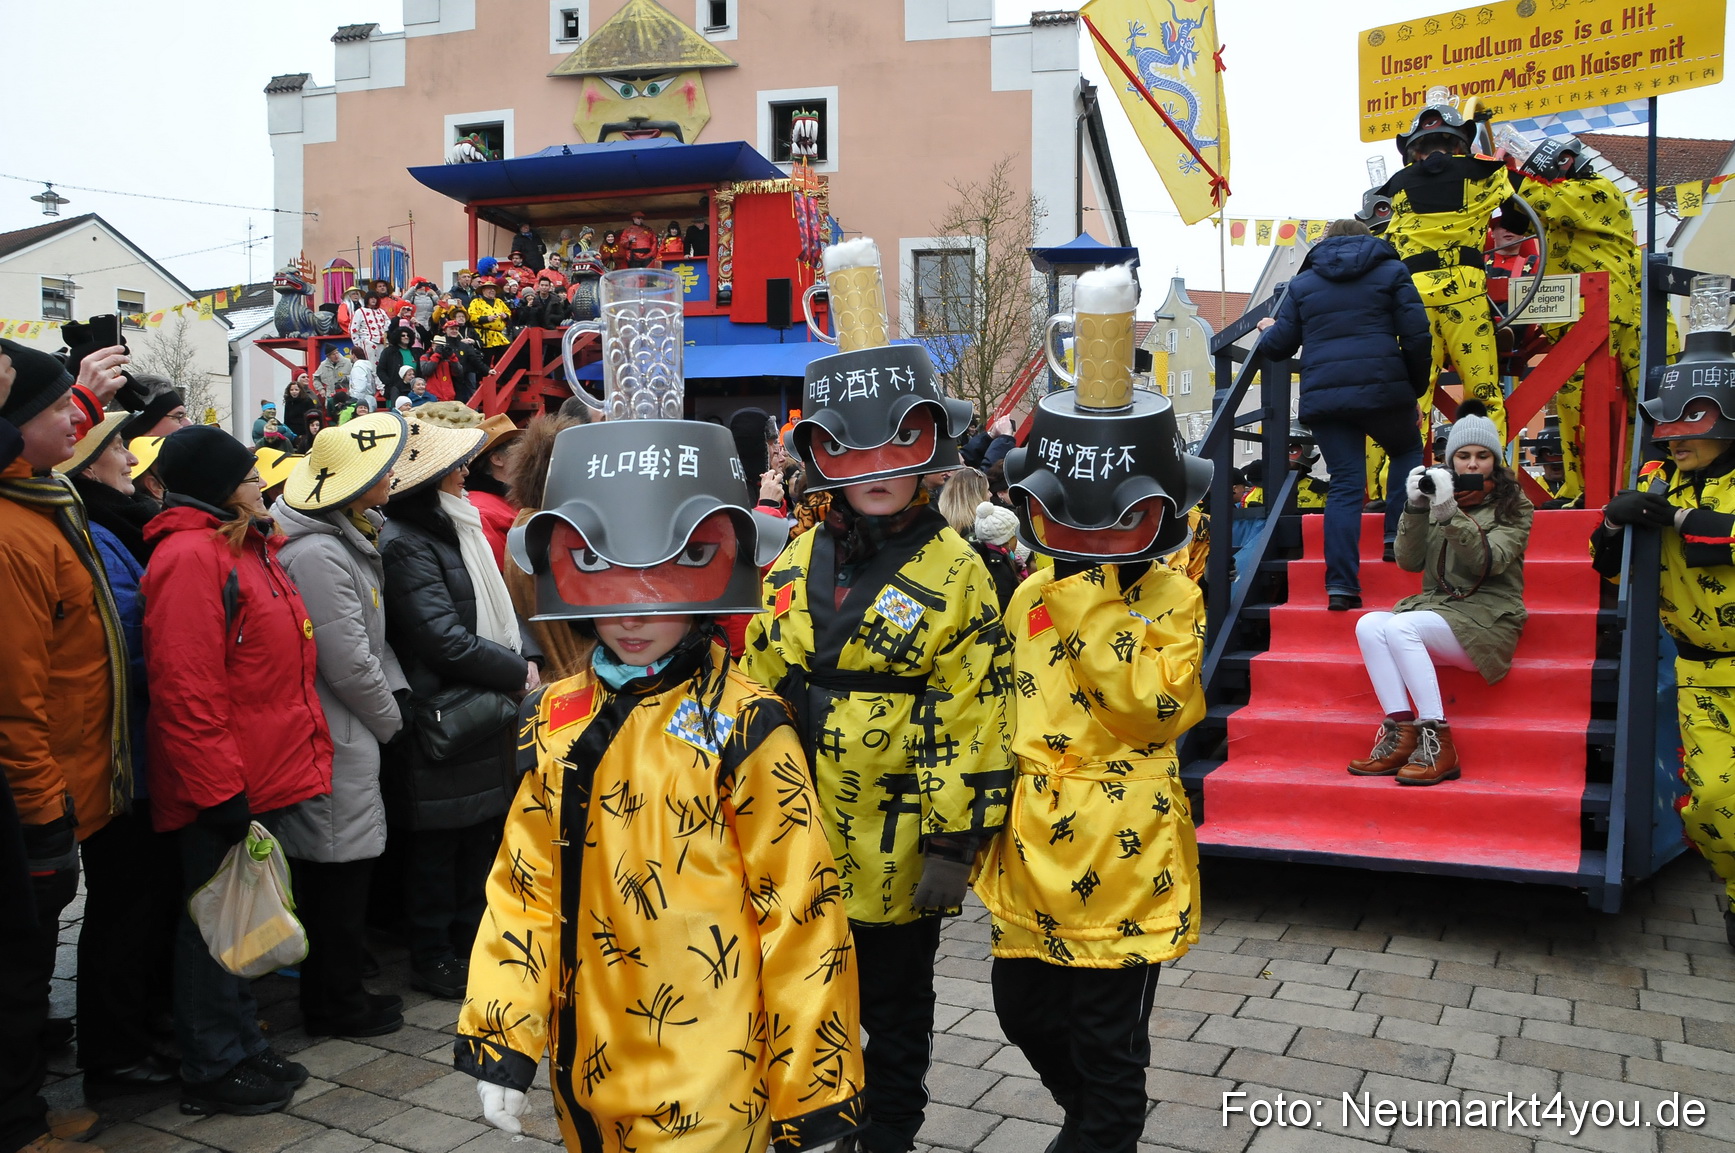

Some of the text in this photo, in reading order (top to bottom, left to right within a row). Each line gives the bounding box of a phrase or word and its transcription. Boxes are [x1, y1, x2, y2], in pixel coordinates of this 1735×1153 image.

[1381, 52, 1433, 76] Unser
[1529, 26, 1564, 49] des
[1574, 19, 1592, 40] is
[1600, 19, 1613, 35] a
[1622, 2, 1657, 31] Hit
[1367, 91, 1399, 113] mir
[1460, 77, 1496, 97] vom
[1552, 63, 1575, 82] an
[1580, 50, 1643, 77] Kaiser
[1650, 35, 1686, 64] mit
[1528, 304, 1558, 314] Gefahr!
[1537, 294, 1565, 304] eigene
